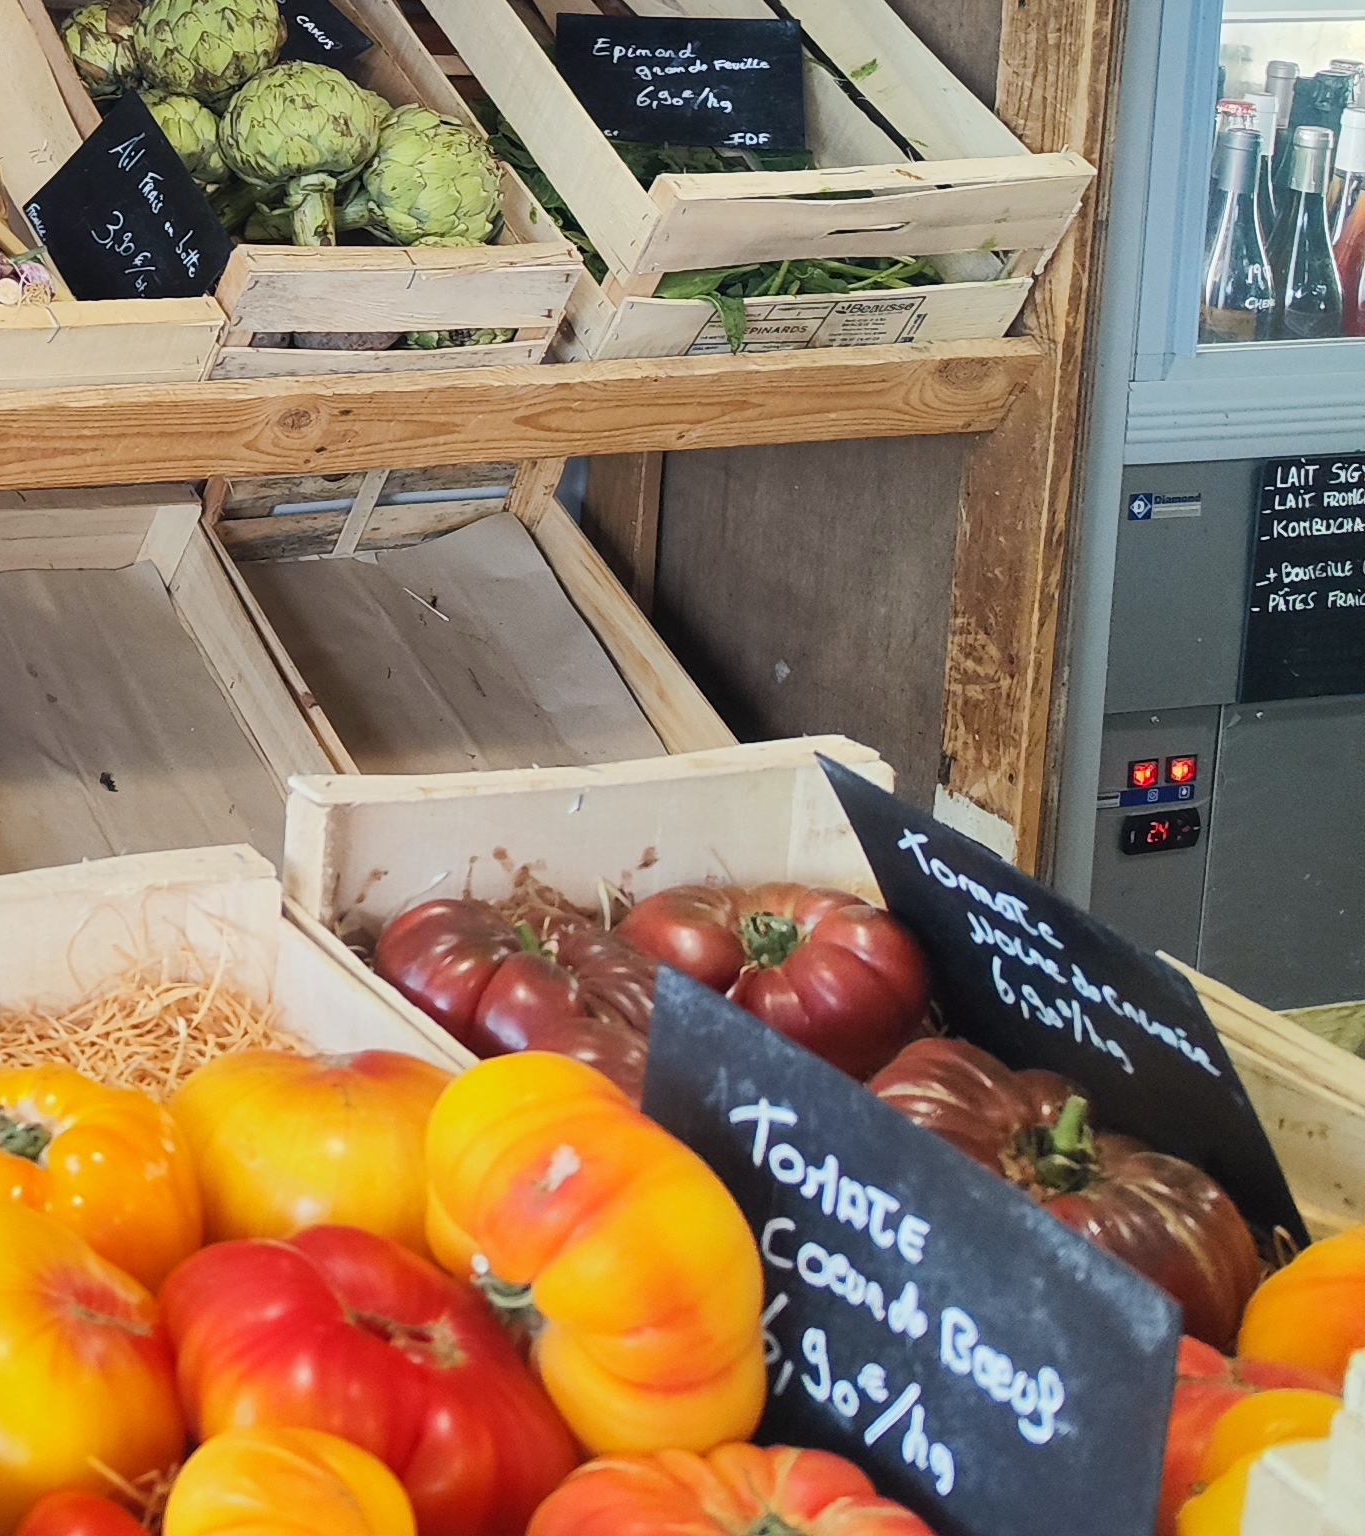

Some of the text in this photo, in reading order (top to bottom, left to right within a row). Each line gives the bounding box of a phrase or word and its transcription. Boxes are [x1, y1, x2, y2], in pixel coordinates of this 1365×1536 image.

[108, 132, 146, 172] Ail
[1276, 457, 1320, 488] LAIT
[1154, 493, 1202, 504] Diamond
[1274, 489, 1318, 511] LAIT
[1281, 560, 1353, 584] BOUTEILLE
[728, 1096, 932, 1266] TOMATE
